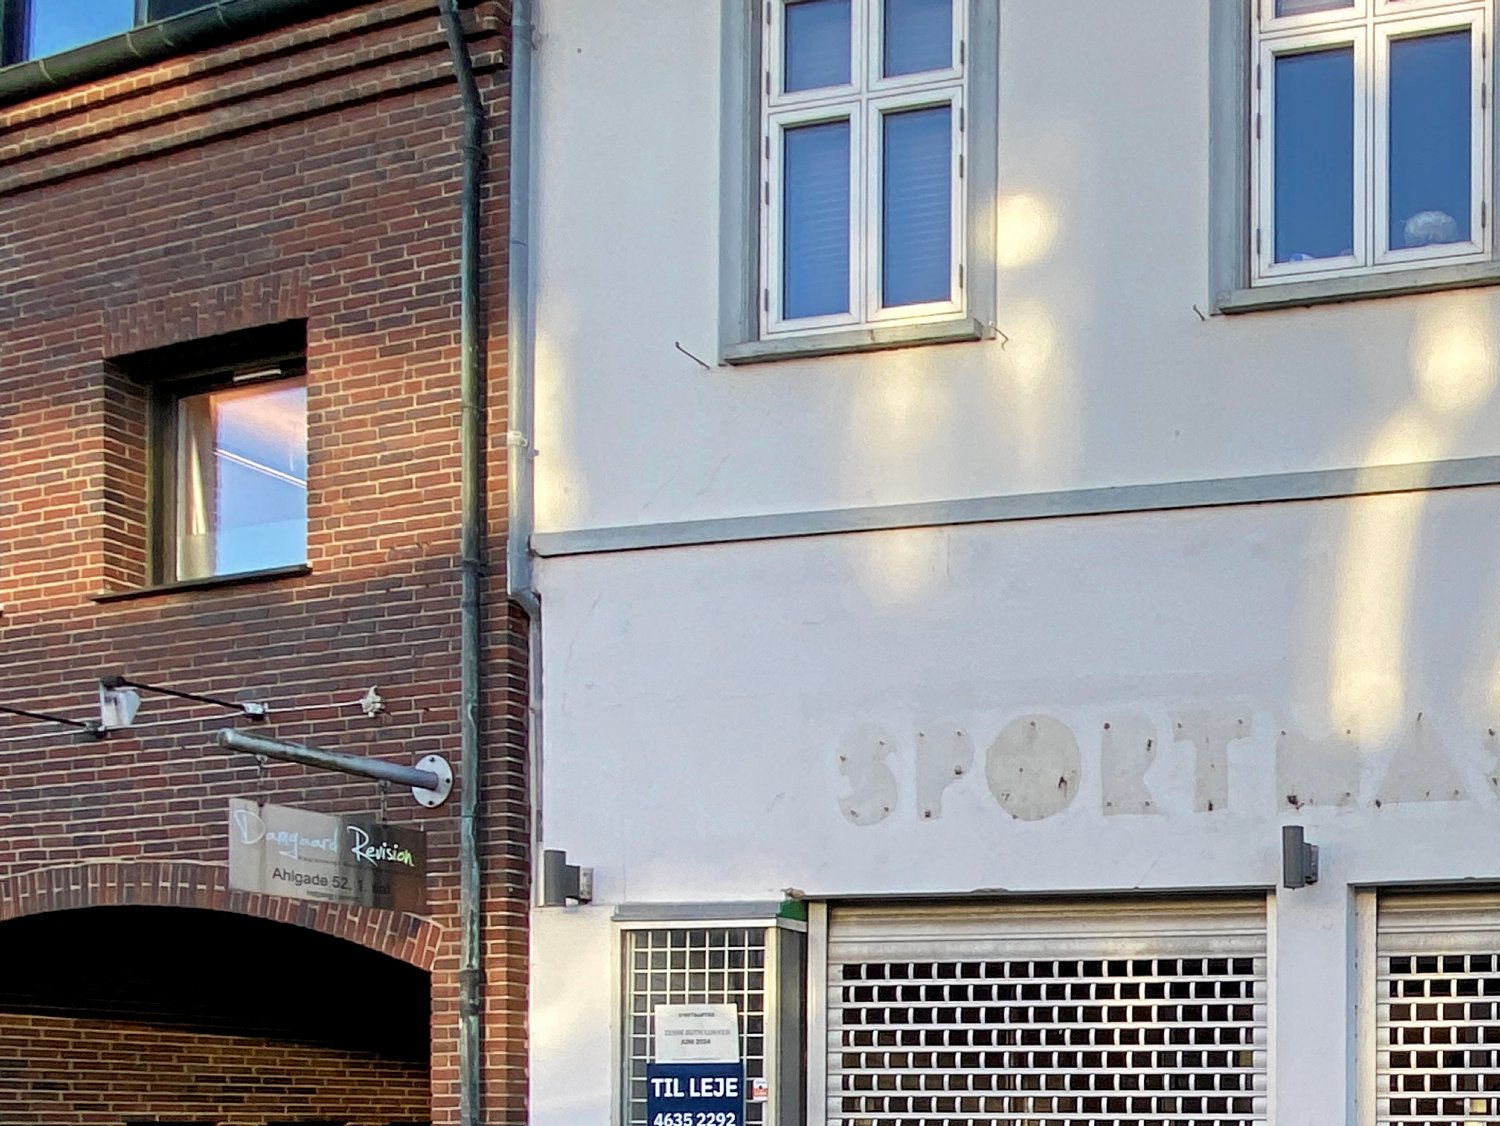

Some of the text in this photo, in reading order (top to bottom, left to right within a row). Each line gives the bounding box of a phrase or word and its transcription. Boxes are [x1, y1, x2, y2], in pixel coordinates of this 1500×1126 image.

[347, 826, 415, 867] Revision
[272, 866, 328, 886] Ahlgade
[651, 1077, 738, 1097] TIL LEJE
